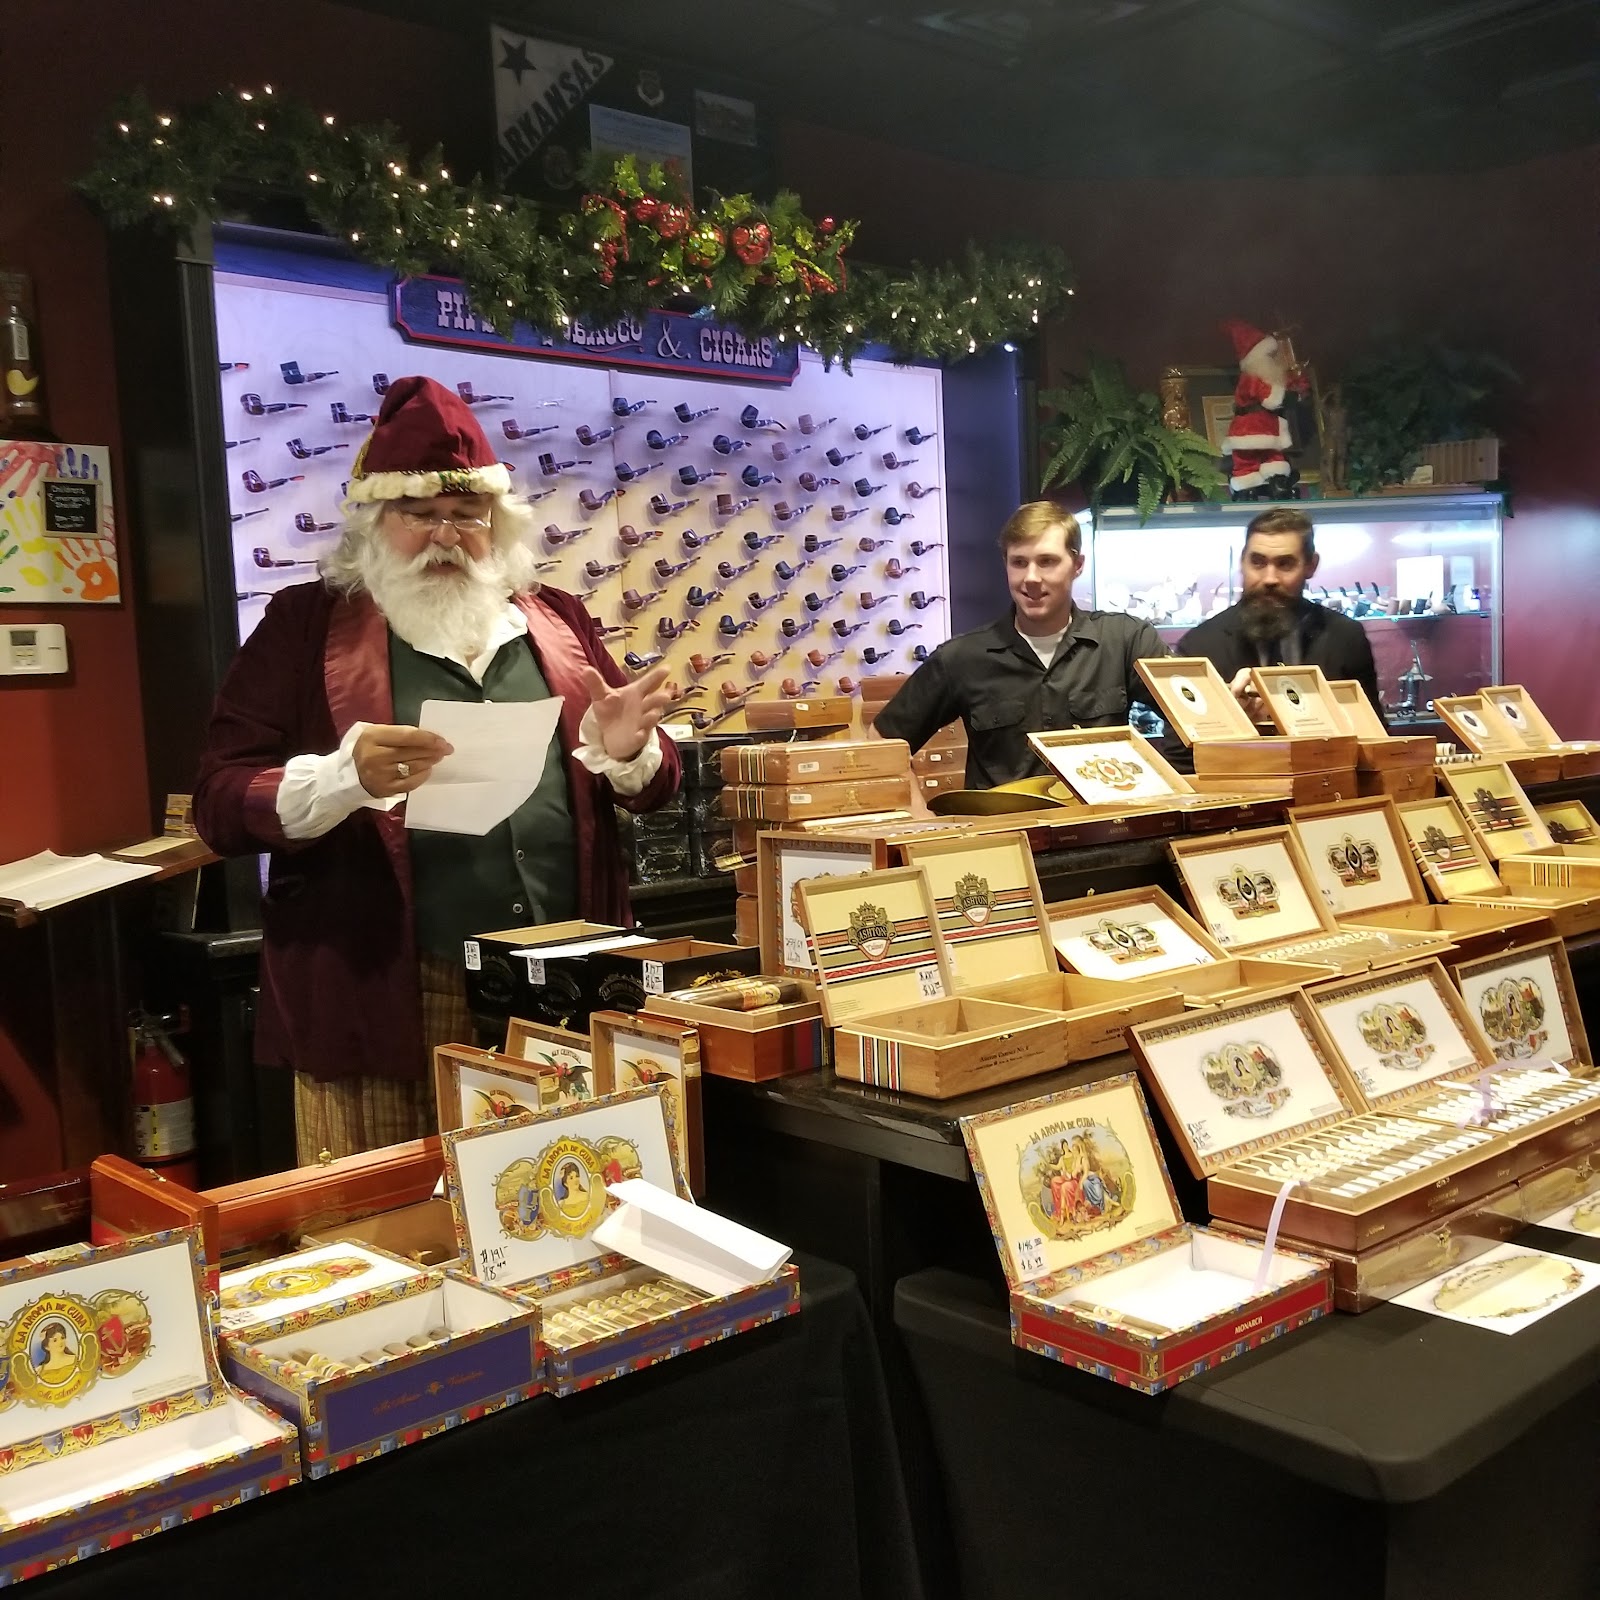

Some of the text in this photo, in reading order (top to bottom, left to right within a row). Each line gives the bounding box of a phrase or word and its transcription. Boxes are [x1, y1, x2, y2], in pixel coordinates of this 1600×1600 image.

[498, 48, 606, 180] ARKANSAS
[542, 317, 643, 347] BACCO
[700, 327, 774, 369] CIGARS
[962, 894, 989, 909] ASHTON
[858, 925, 888, 941] ASHTON
[1029, 1117, 1096, 1145] LA AROMA DE CUBA
[542, 1143, 595, 1180] LA AROMA DE CUBA
[16, 1301, 88, 1344] LA AROMA DE CUBA
[1234, 1315, 1263, 1335] MONARCH
